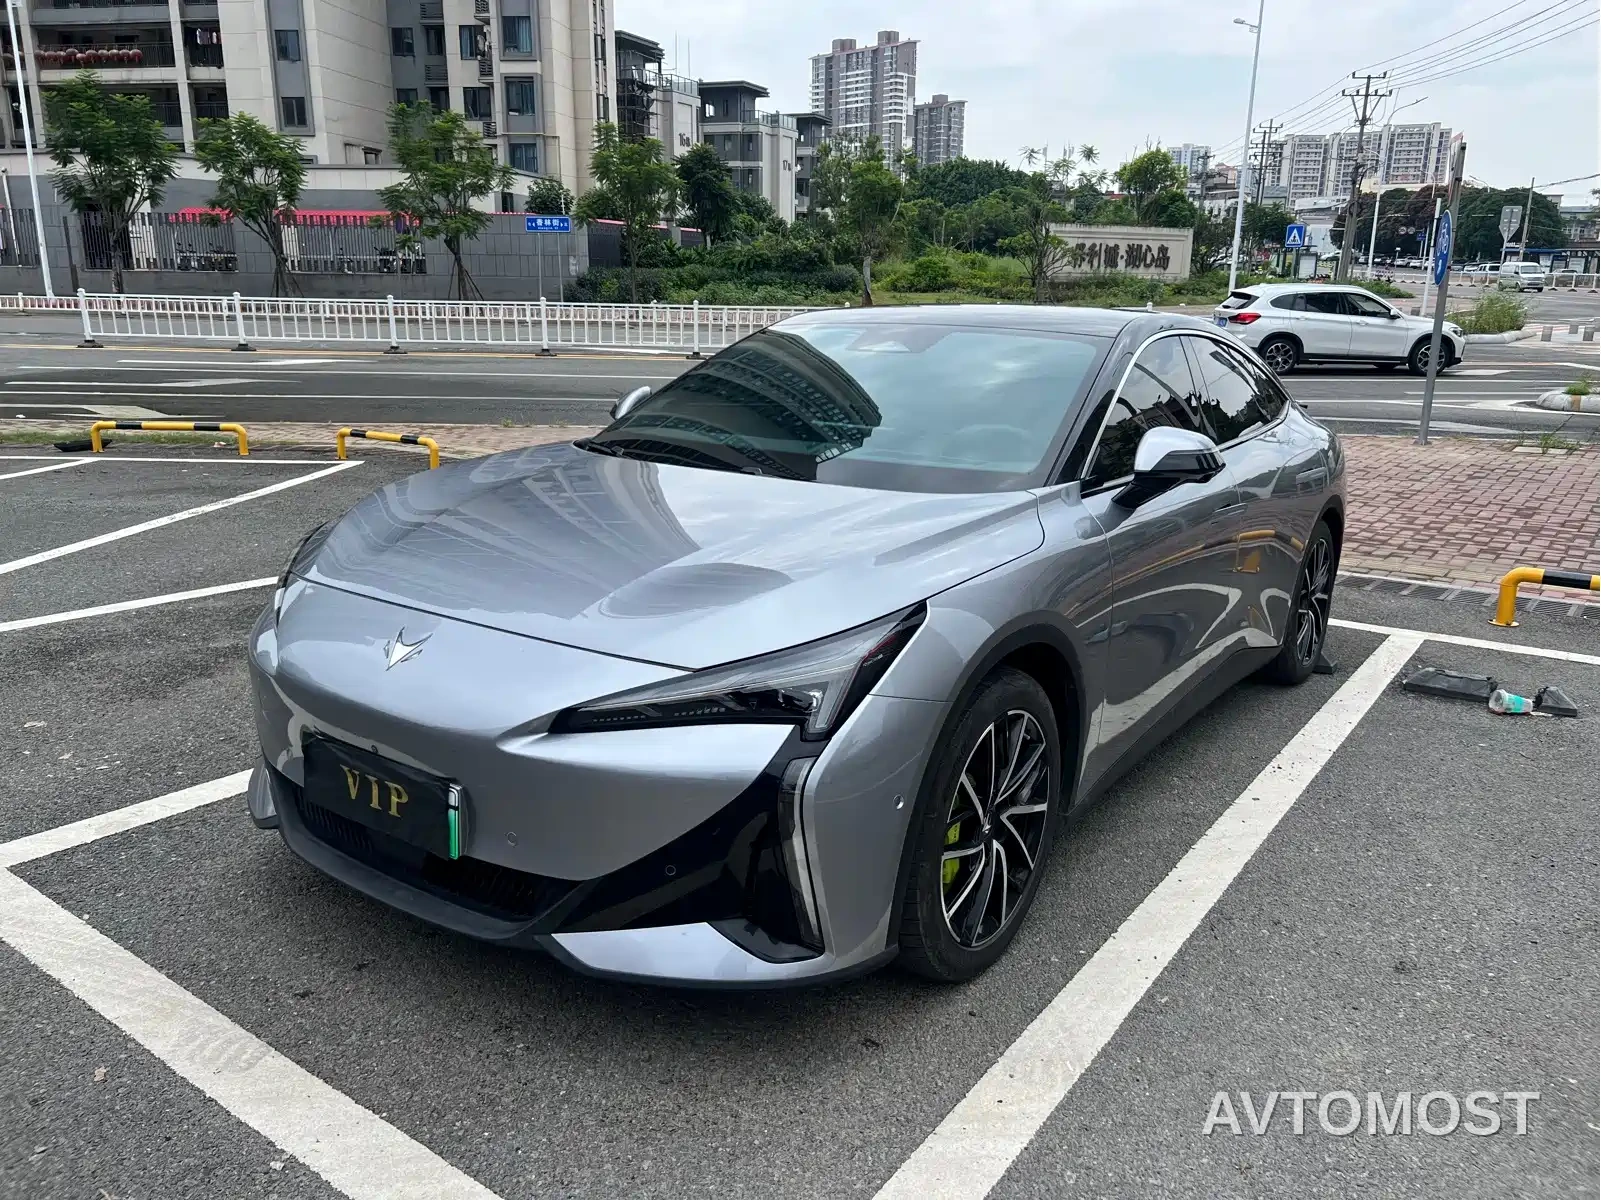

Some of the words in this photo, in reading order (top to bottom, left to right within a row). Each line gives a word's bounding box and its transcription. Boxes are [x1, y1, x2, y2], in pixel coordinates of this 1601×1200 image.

[537, 219, 559, 227] 香林街
[339, 764, 409, 818] VIP
